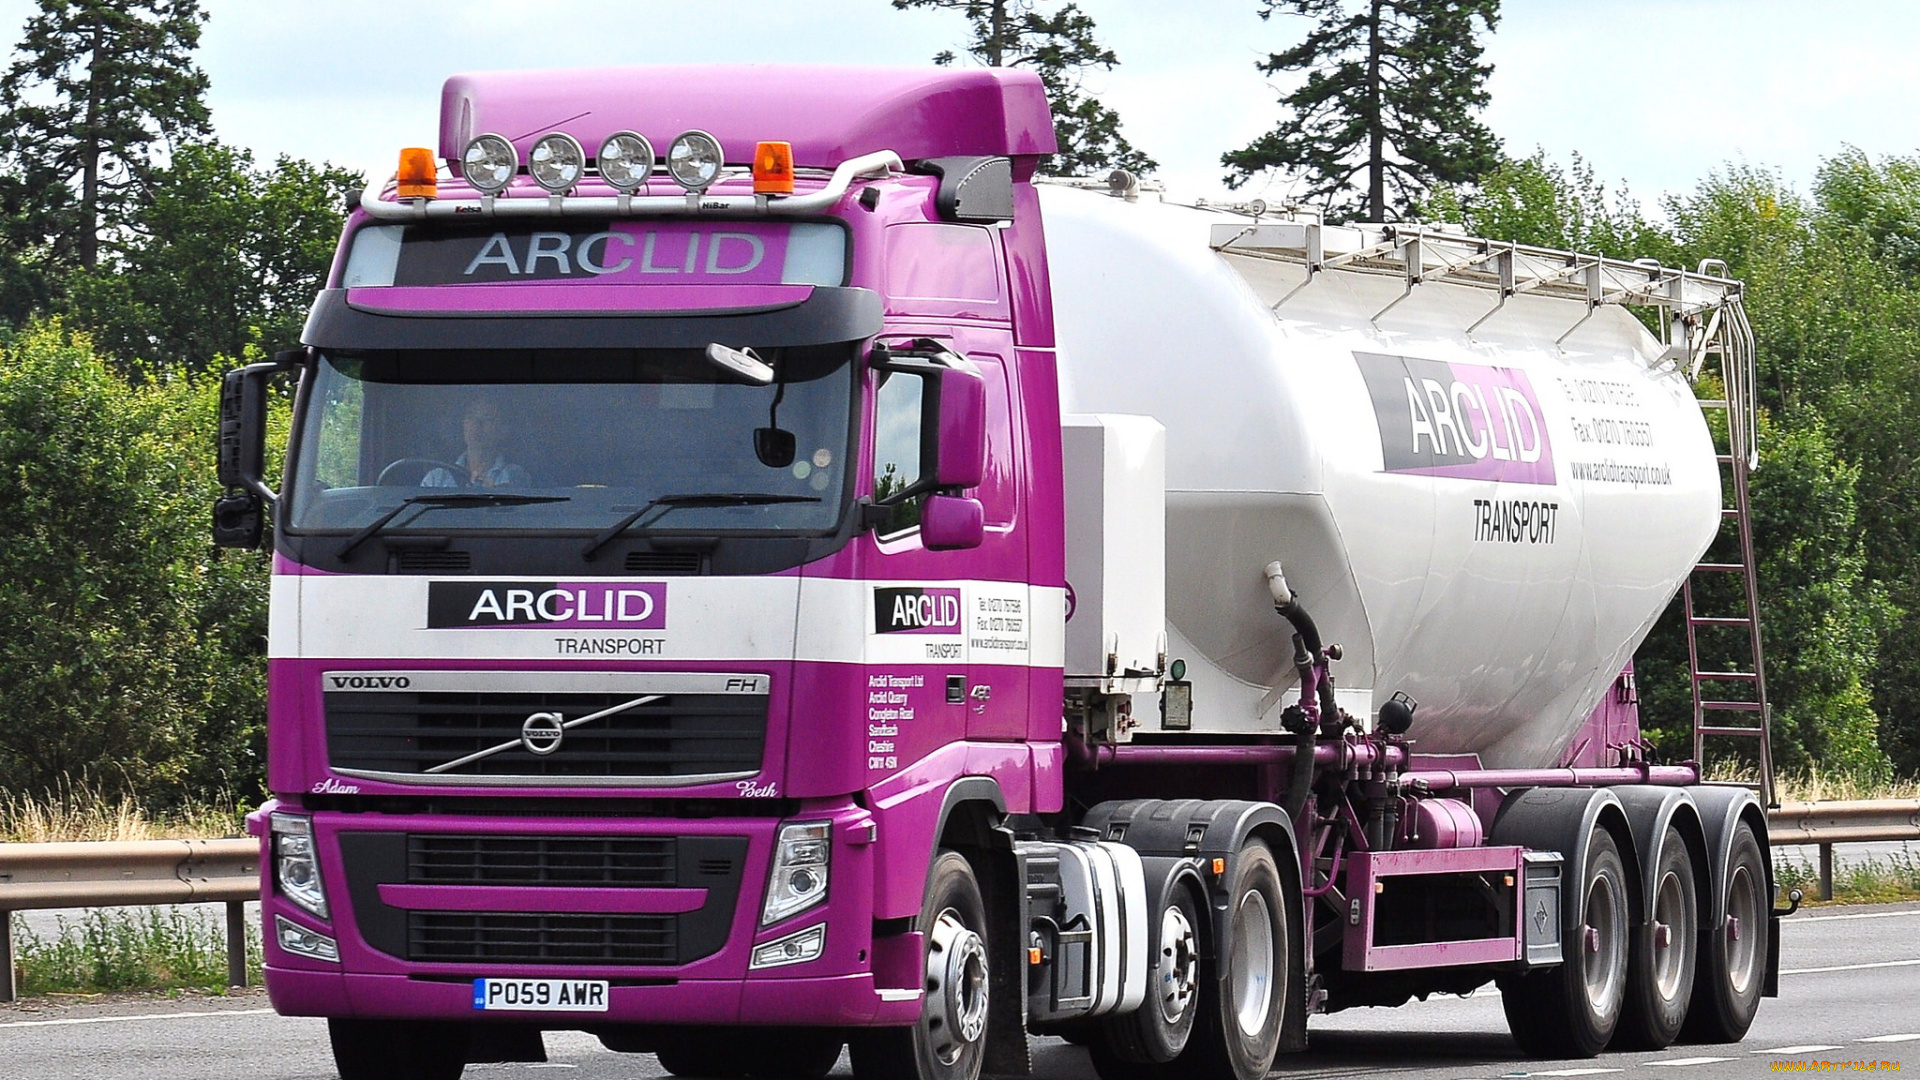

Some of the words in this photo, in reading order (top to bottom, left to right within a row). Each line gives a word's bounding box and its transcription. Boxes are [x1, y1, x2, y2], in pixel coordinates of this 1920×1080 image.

[702, 201, 730, 209] HiBar
[463, 231, 765, 275] ARCLID
[1403, 376, 1542, 463] ARCLID
[1592, 418, 1621, 445] 01270
[1473, 499, 1559, 544] TRANSPORT
[468, 589, 654, 622] ARCLID
[892, 595, 959, 627] ARCLID
[555, 638, 666, 655] TRANSPORT
[925, 643, 963, 659] TRANSPORT
[331, 676, 411, 689] VOLVO
[725, 678, 757, 692] FH
[524, 730, 561, 738] VOLVO
[312, 778, 360, 794] Adam
[736, 781, 779, 797] Beth
[558, 982, 604, 1006] AWR
